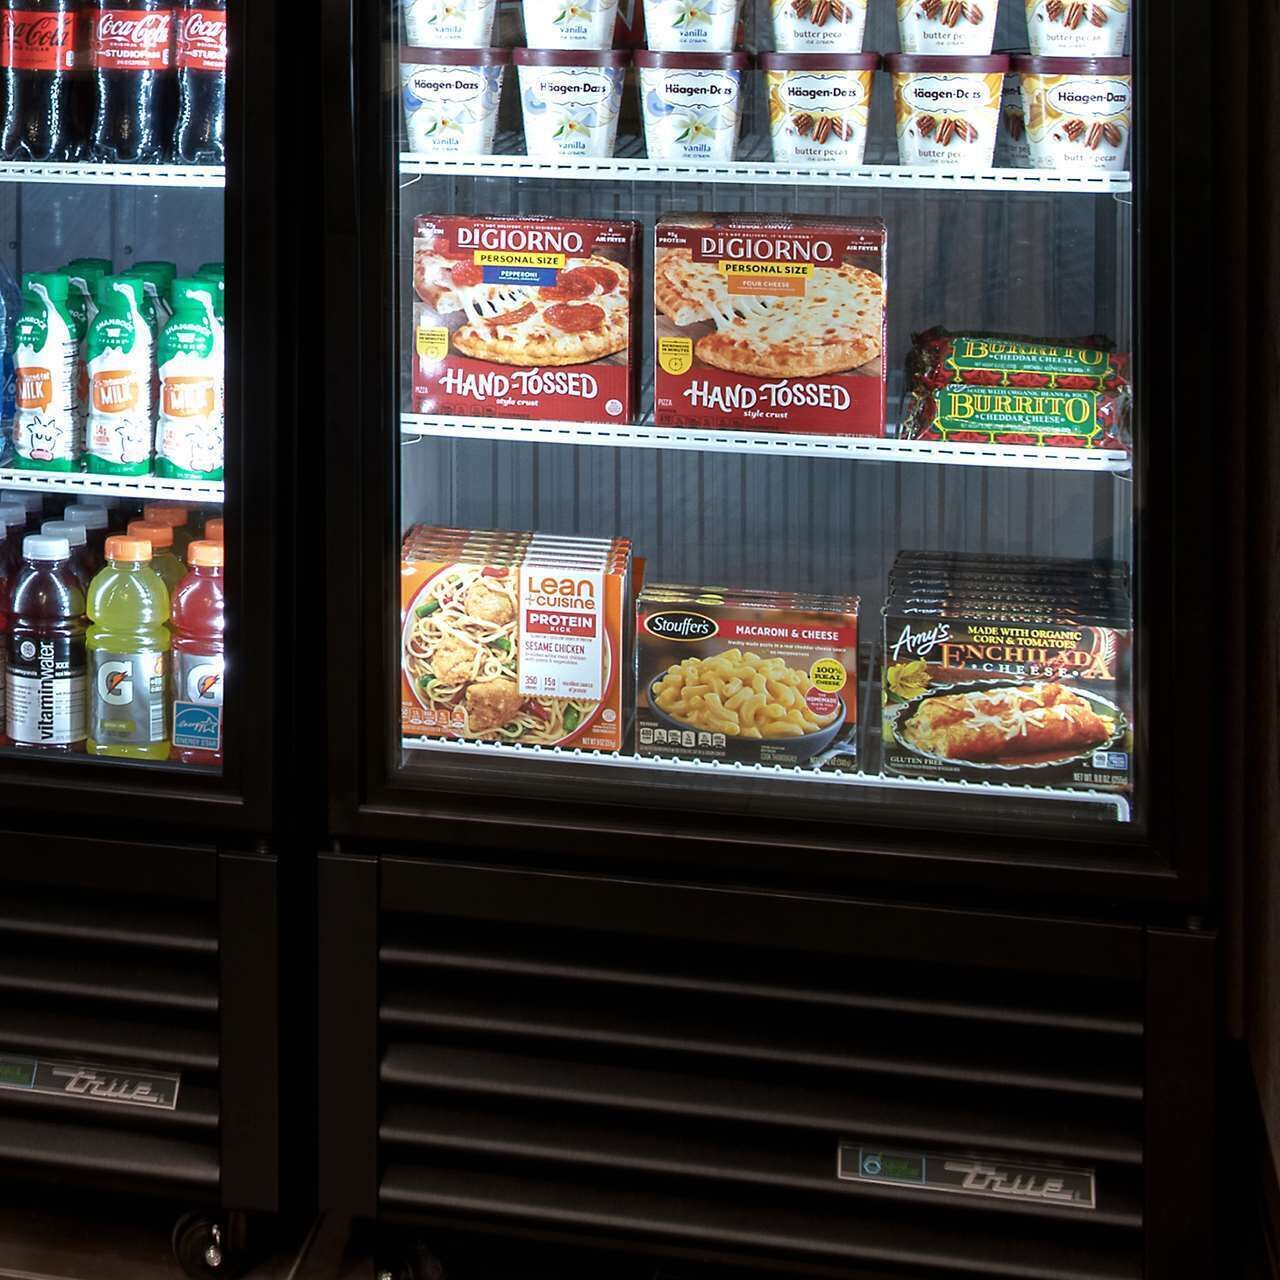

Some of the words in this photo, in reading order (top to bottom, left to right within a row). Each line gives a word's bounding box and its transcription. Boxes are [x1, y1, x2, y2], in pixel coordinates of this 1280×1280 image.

[99, 13, 170, 43] Coca-Cola
[793, 29, 820, 39] butter
[923, 30, 951, 40] butter
[414, 79, 479, 92] Häagen-Dazs
[1057, 91, 1127, 105] Häagen-Dazs
[794, 147, 821, 157] butter
[457, 227, 584, 252] DIGIORNO
[700, 237, 833, 262] DIGIORNO
[480, 254, 535, 265] PERSONAL
[536, 256, 559, 265] SIZE
[500, 270, 538, 278] PEPPERONI
[725, 264, 782, 274] PERSONAL
[784, 265, 808, 275] SIZE
[742, 280, 762, 288] FOUR
[993, 353, 1037, 362] CHEDDAR
[1039, 356, 1074, 364] CHEESE
[18, 376, 44, 401] MILK
[439, 367, 598, 400] HAND-TOSSED
[100, 384, 132, 404] MILK
[496, 397, 515, 407] style
[683, 379, 851, 412] HAND-TOSSED
[743, 409, 764, 418] style
[765, 411, 788, 419] crust
[947, 392, 1090, 424] BURRITO
[979, 413, 1024, 422] CHEDDAR
[1026, 415, 1060, 423] CHEESE
[528, 576, 595, 598] Lean
[529, 612, 593, 628] PROTEIN
[652, 616, 710, 636] Stouffer's
[735, 625, 789, 638] MACARONI
[791, 629, 799, 638] &
[801, 630, 840, 641] CHEESE
[967, 625, 999, 637] MADE
[1000, 627, 1029, 638] WITH
[1031, 628, 1083, 641] ORGANIC
[525, 640, 553, 653] SESAME
[554, 643, 585, 655] CHICKEN
[890, 622, 954, 662] Amy's
[973, 634, 1005, 645] CORN
[1005, 636, 1015, 646] &
[1017, 637, 1078, 650] TOMATOES
[939, 642, 1116, 681] ENCHILADA
[38, 640, 55, 741] vitaminwater
[97, 660, 135, 706] G
[187, 662, 224, 704] G
[889, 755, 923, 765] GLUTEN
[924, 757, 944, 767] FREE
